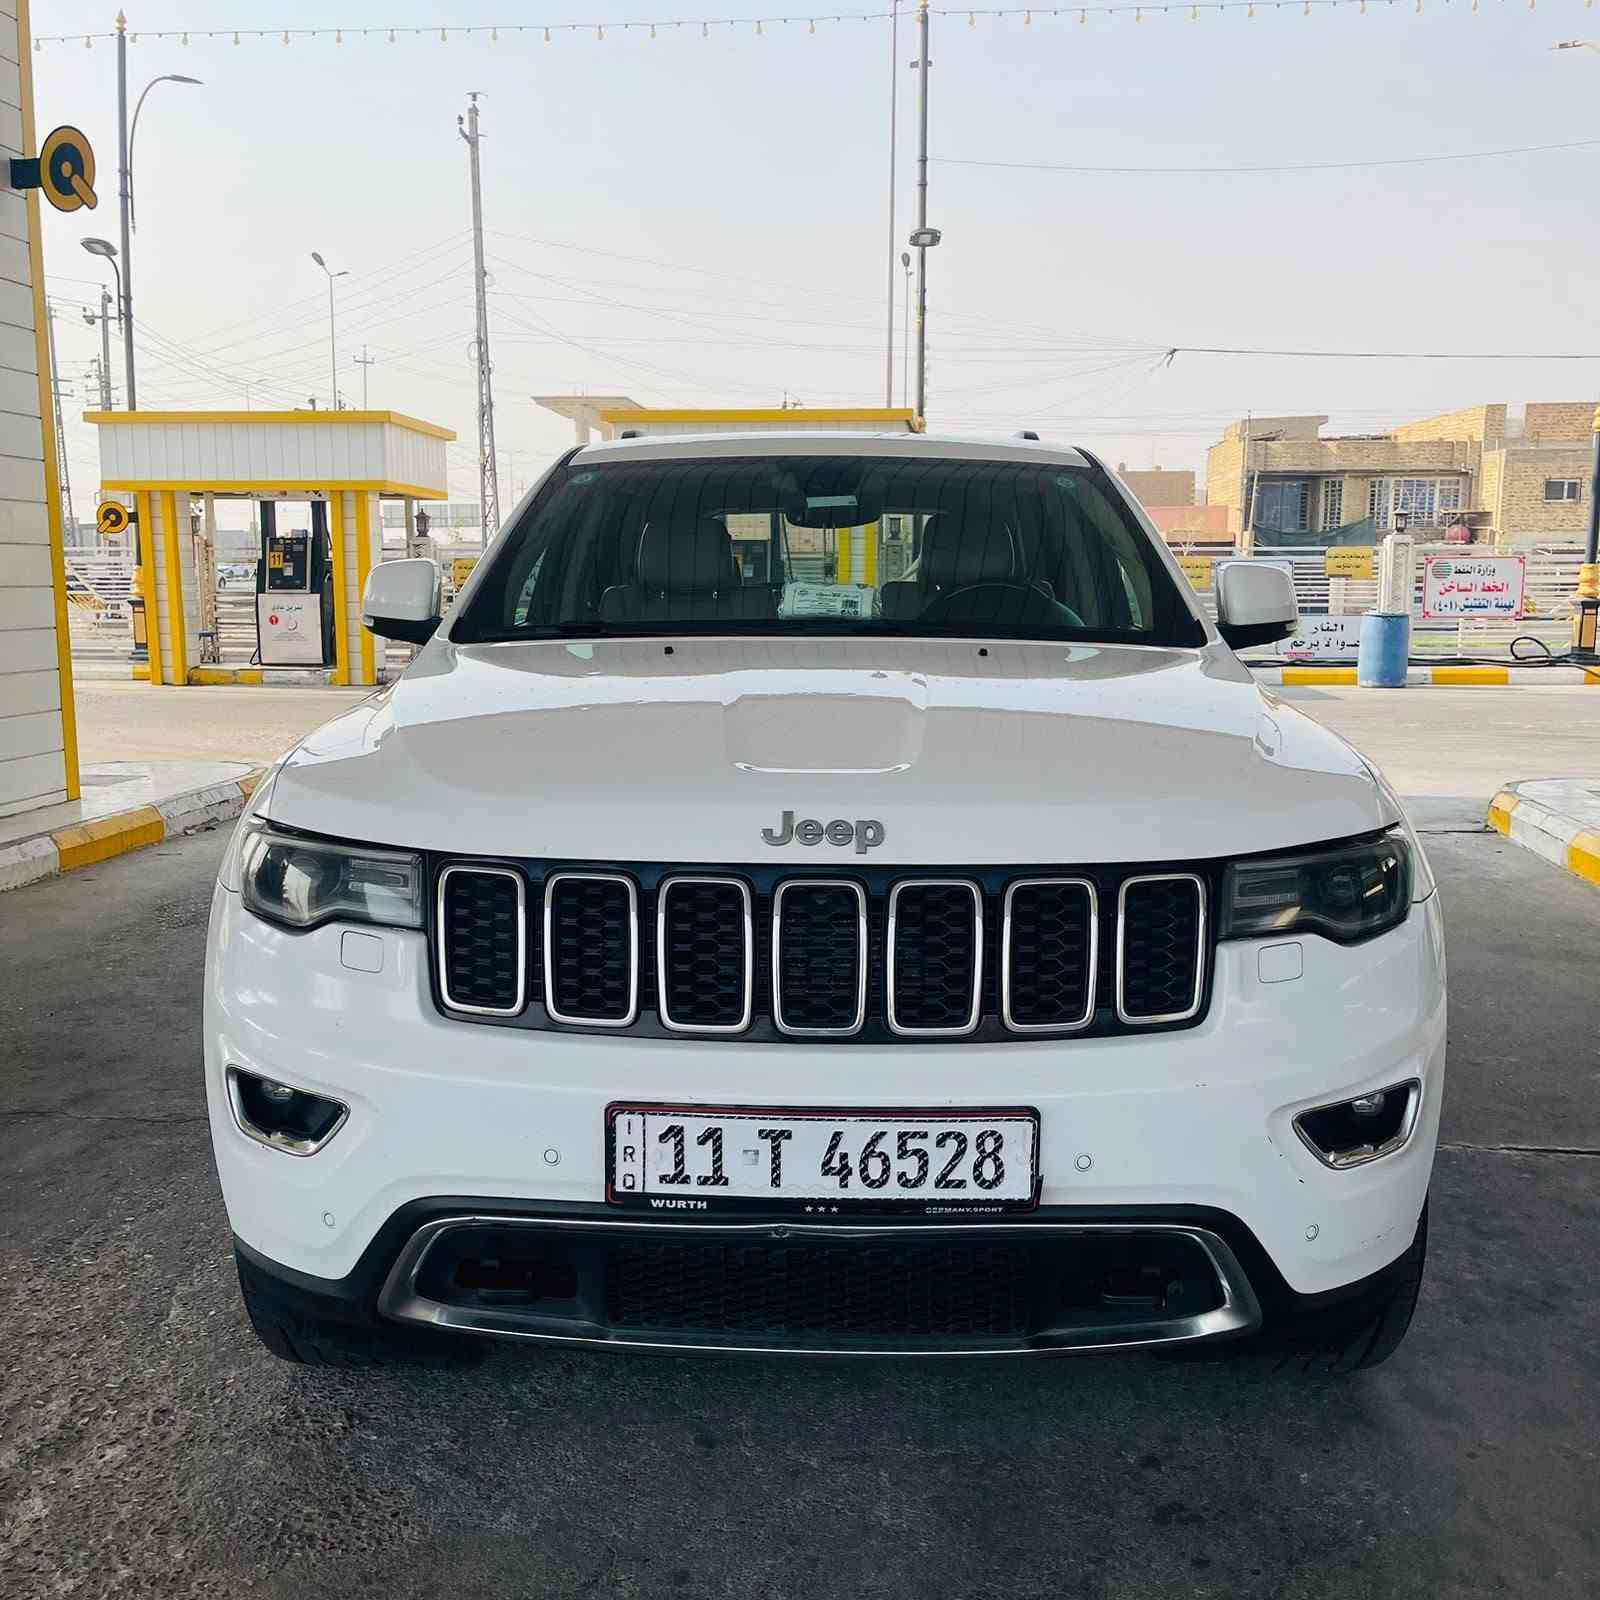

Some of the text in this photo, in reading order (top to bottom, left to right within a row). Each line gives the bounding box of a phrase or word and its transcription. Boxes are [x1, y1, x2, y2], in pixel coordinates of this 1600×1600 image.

[271, 553, 281, 566] 11
[1454, 563, 1496, 576] وزارة النفط
[1439, 580, 1509, 596] الخط الساخن
[1459, 597, 1492, 612] التفتيش
[760, 811, 885, 854] Jeep
[658, 1124, 1006, 1190] 11 T 46528
[650, 1198, 708, 1209] WURTH
